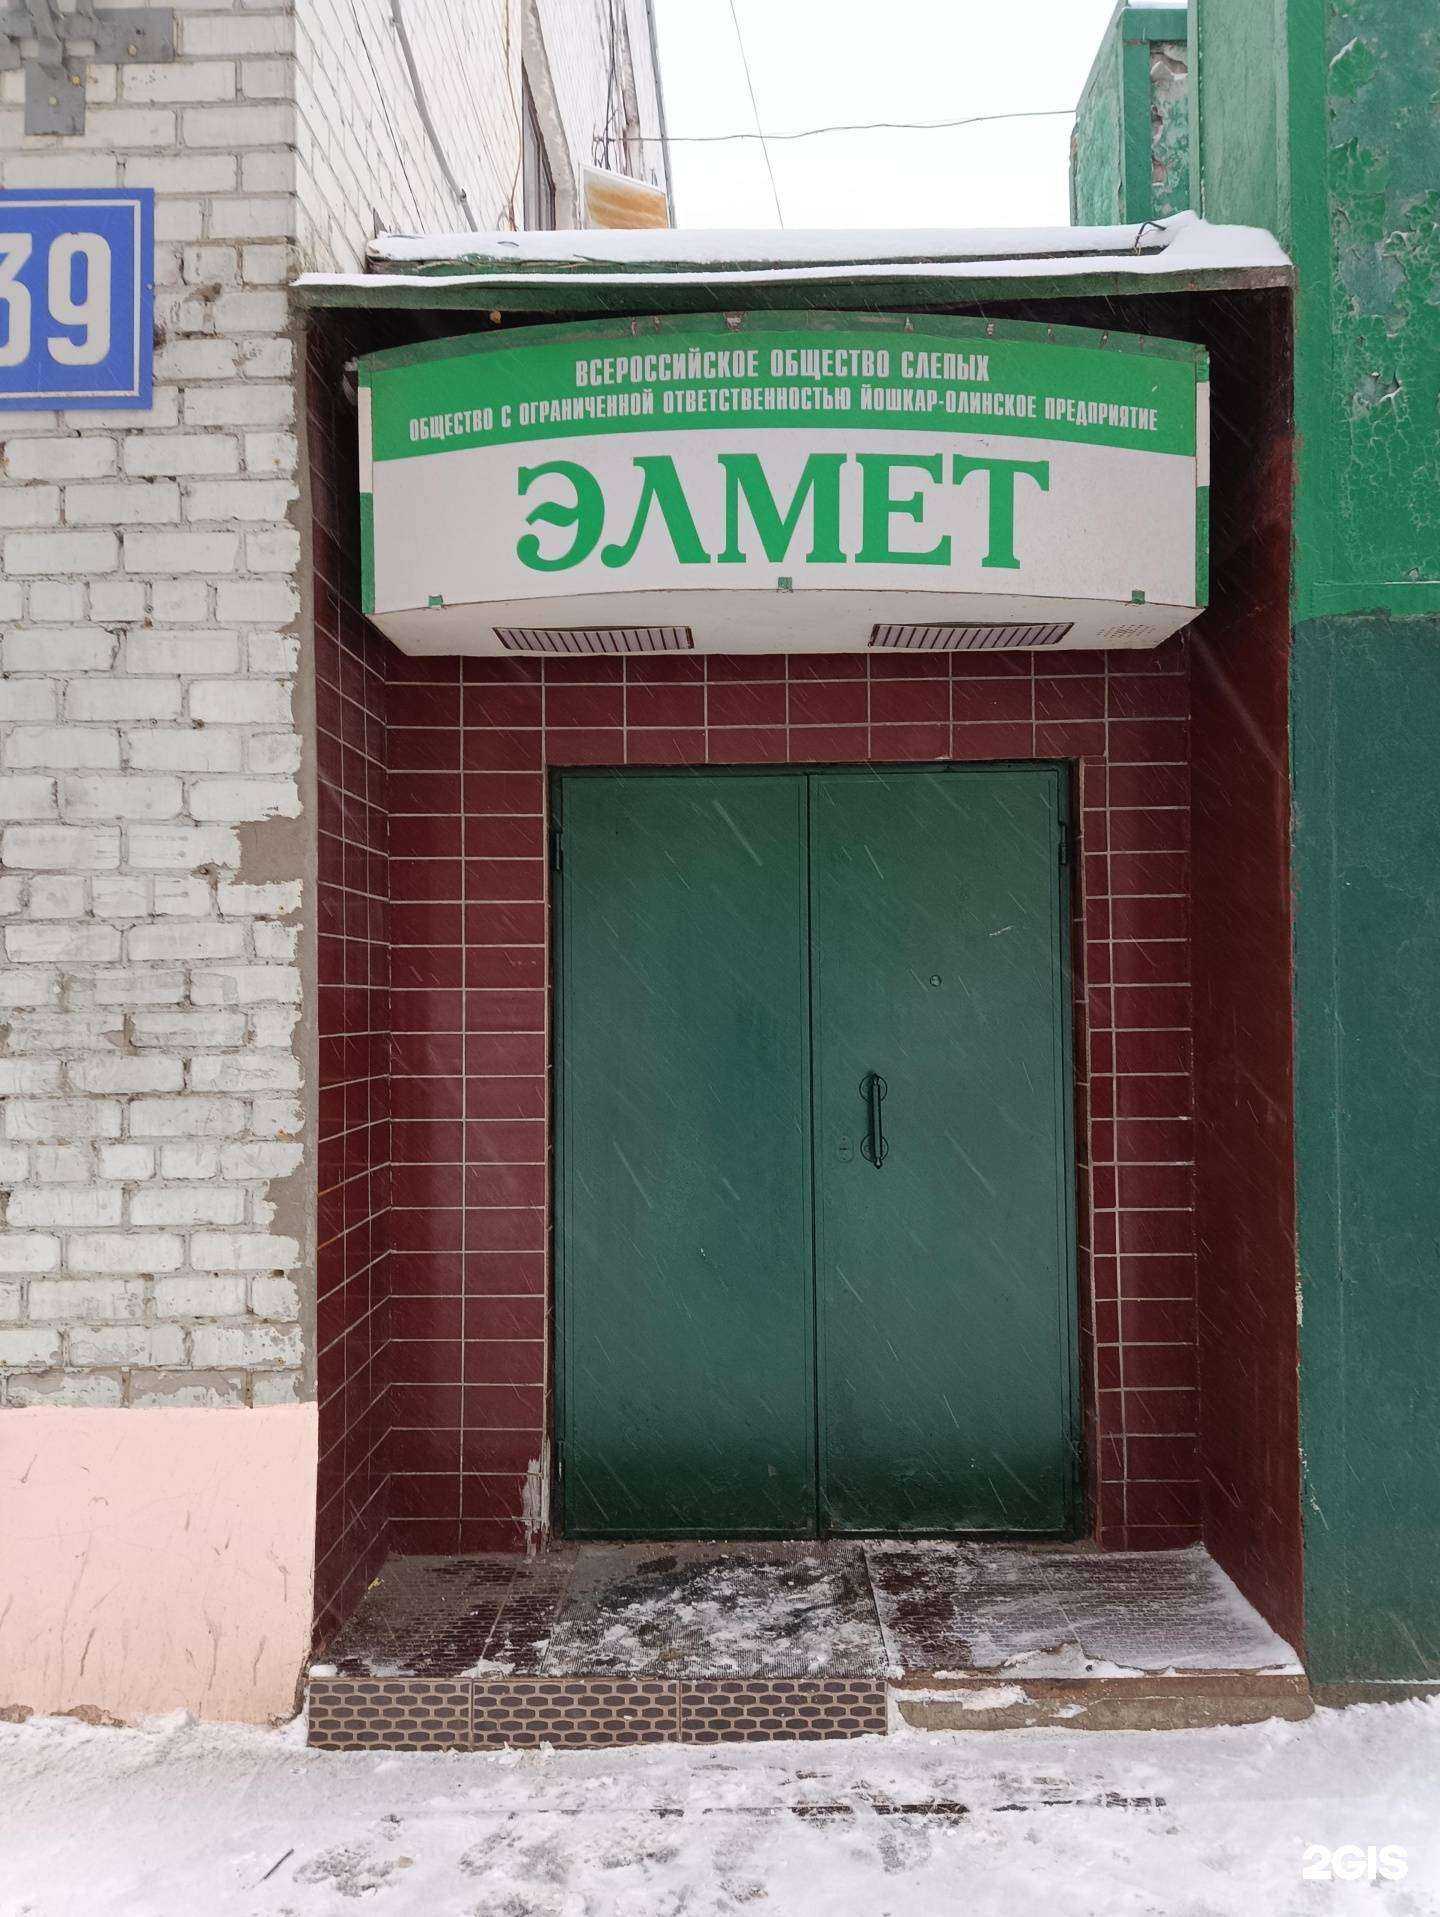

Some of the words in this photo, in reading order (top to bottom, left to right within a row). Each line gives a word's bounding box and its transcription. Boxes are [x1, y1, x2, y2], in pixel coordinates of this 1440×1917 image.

[575, 347, 759, 387] ВСЕРОССИЙСКОЕ
[770, 349, 890, 381] ОБЩЕСТВО
[901, 351, 990, 382] СЛЕПЫХ
[409, 407, 493, 442] ОБЩЕСТВО
[501, 405, 512, 428] С
[519, 388, 654, 426] ОГРАНИЧЕННОЙ
[662, 386, 851, 414] ОТВЕТСТВЕННОСТЬЮ
[860, 384, 1037, 419] ЙОШКАР-ОЛИНСКОЕ
[1044, 397, 1158, 432] ПРЕДПРИЯТИЕ
[516, 453, 1049, 573] ЭЛМЕТ
